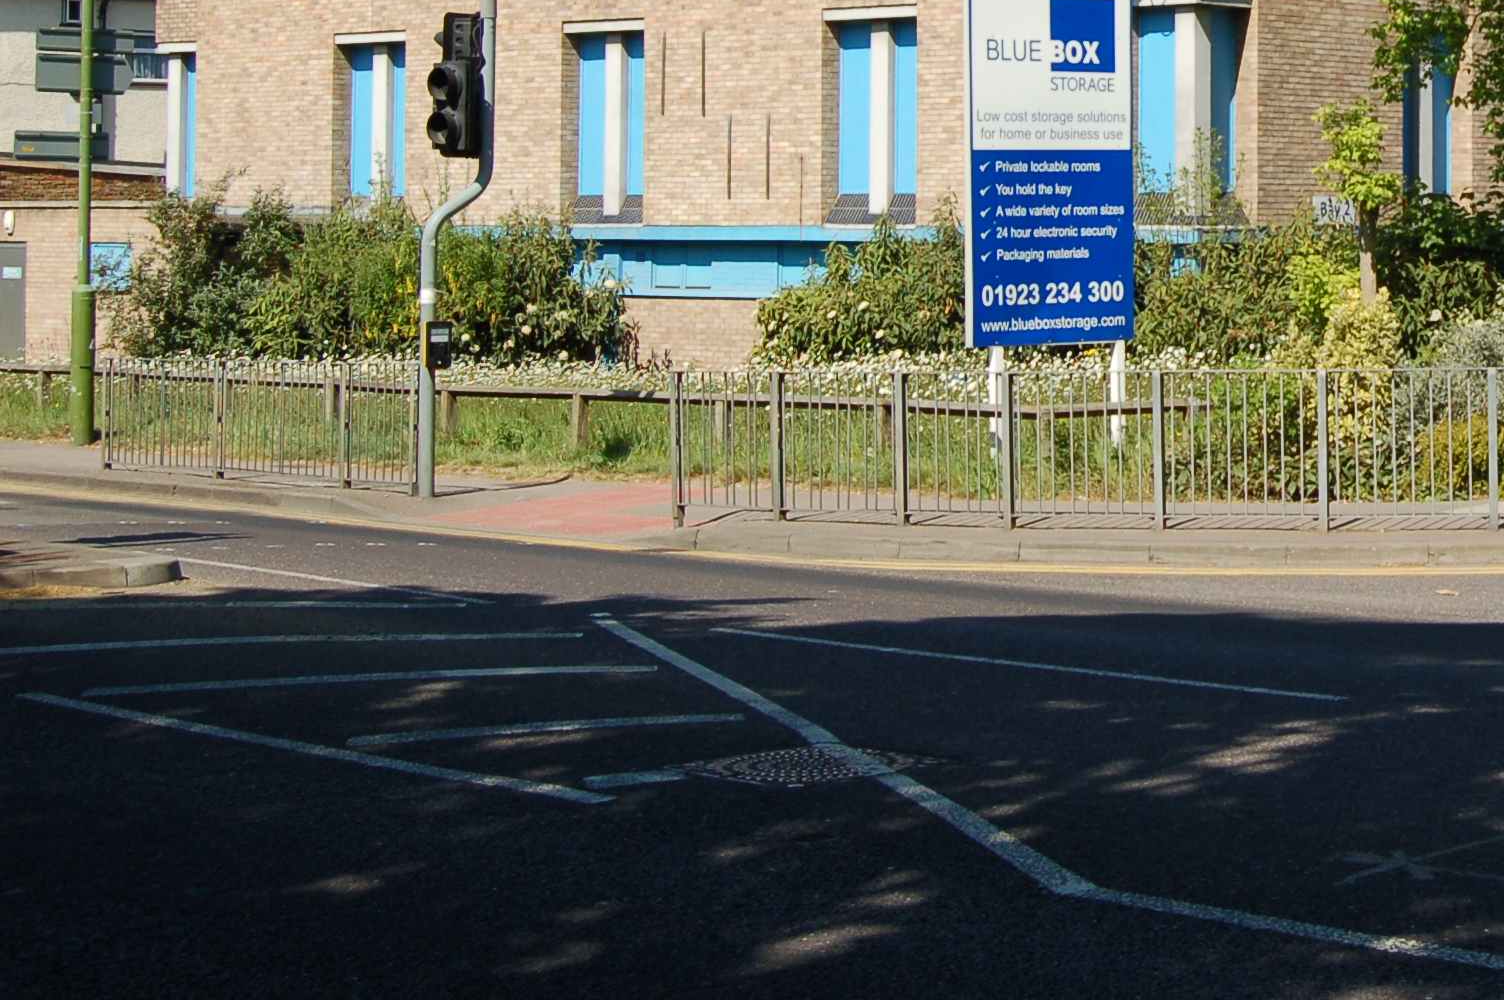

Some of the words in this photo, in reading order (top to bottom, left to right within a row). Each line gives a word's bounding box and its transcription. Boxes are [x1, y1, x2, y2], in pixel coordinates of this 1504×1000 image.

[986, 38, 1042, 62] BLUE
[1050, 39, 1100, 65] BOX
[1050, 76, 1116, 93] STORAGE
[976, 109, 1000, 122] Low
[1004, 110, 1028, 122] cost
[1031, 110, 1074, 125] storage
[1077, 110, 1127, 123] solutions
[980, 127, 995, 140] for
[999, 128, 1031, 140] home
[1035, 130, 1046, 140] or
[1049, 128, 1099, 140] business
[1103, 130, 1123, 140] use
[995, 161, 1028, 173] Private
[1030, 161, 1069, 173] lockable
[1071, 162, 1101, 173] rooms
[995, 184, 1013, 196] You
[1016, 183, 1036, 196] hold
[1038, 183, 1053, 195] the
[1055, 183, 1073, 197] key
[995, 206, 1004, 217] A
[1005, 205, 1026, 217] wide
[1029, 204, 1060, 218] variety
[1061, 204, 1073, 216] of
[1073, 205, 1098, 216] room
[1100, 203, 1125, 216] sizes
[996, 227, 1008, 239] 24
[1011, 226, 1031, 238] hour
[1033, 226, 1078, 238] electronic
[1081, 225, 1118, 239] security
[996, 249, 1044, 263] Packaging
[1046, 247, 1090, 260] materials
[981, 283, 1040, 307] 01923
[1045, 281, 1083, 304] 234
[1087, 280, 1125, 303] 300
[981, 315, 1126, 333] www.blueboxstorage.com
